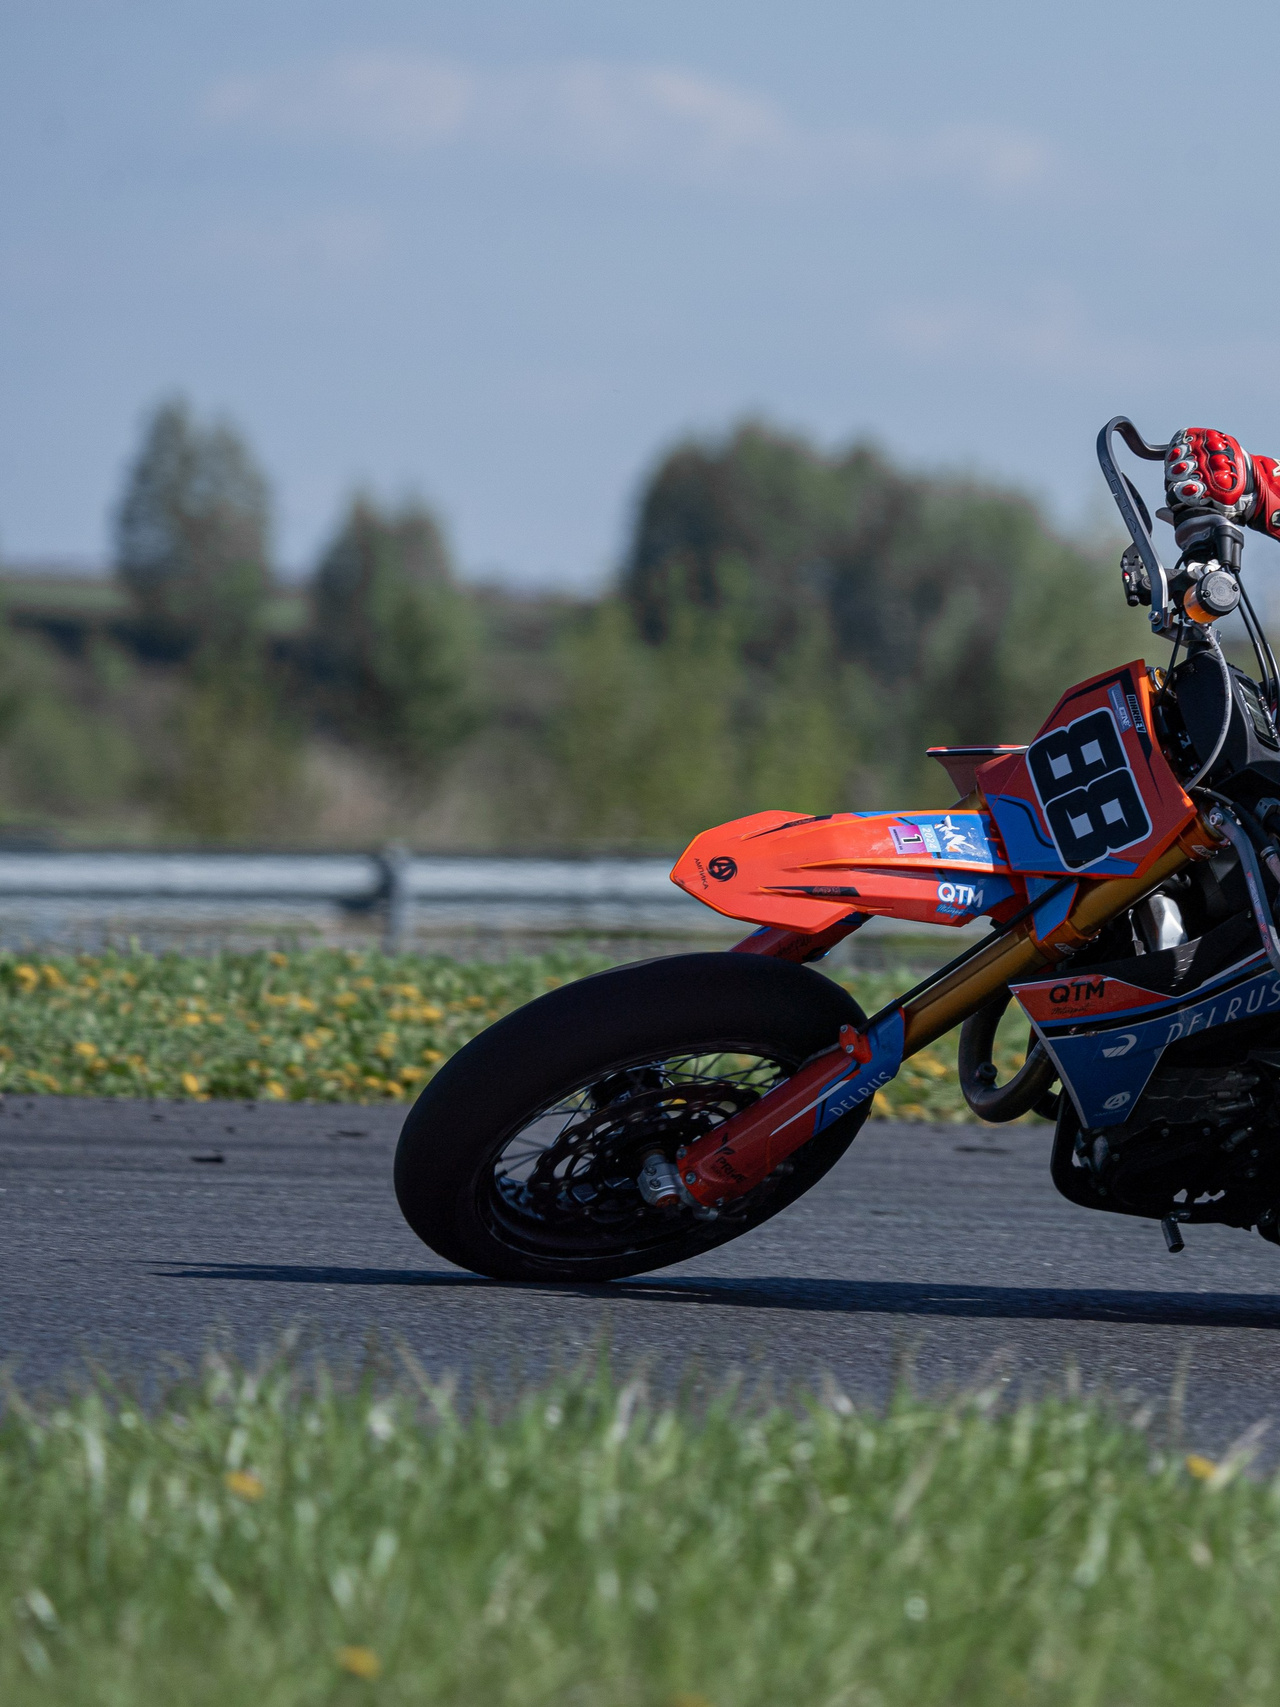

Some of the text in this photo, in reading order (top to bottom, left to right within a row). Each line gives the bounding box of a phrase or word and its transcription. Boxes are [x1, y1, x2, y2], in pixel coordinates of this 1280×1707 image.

[1026, 709, 1152, 871] 88
[901, 833, 923, 845] 1
[921, 827, 937, 850] 2024
[694, 857, 709, 890] АМПИКА
[937, 882, 984, 908] QTM
[1049, 978, 1105, 1004] QTM
[828, 1071, 893, 1117] DELRUS
